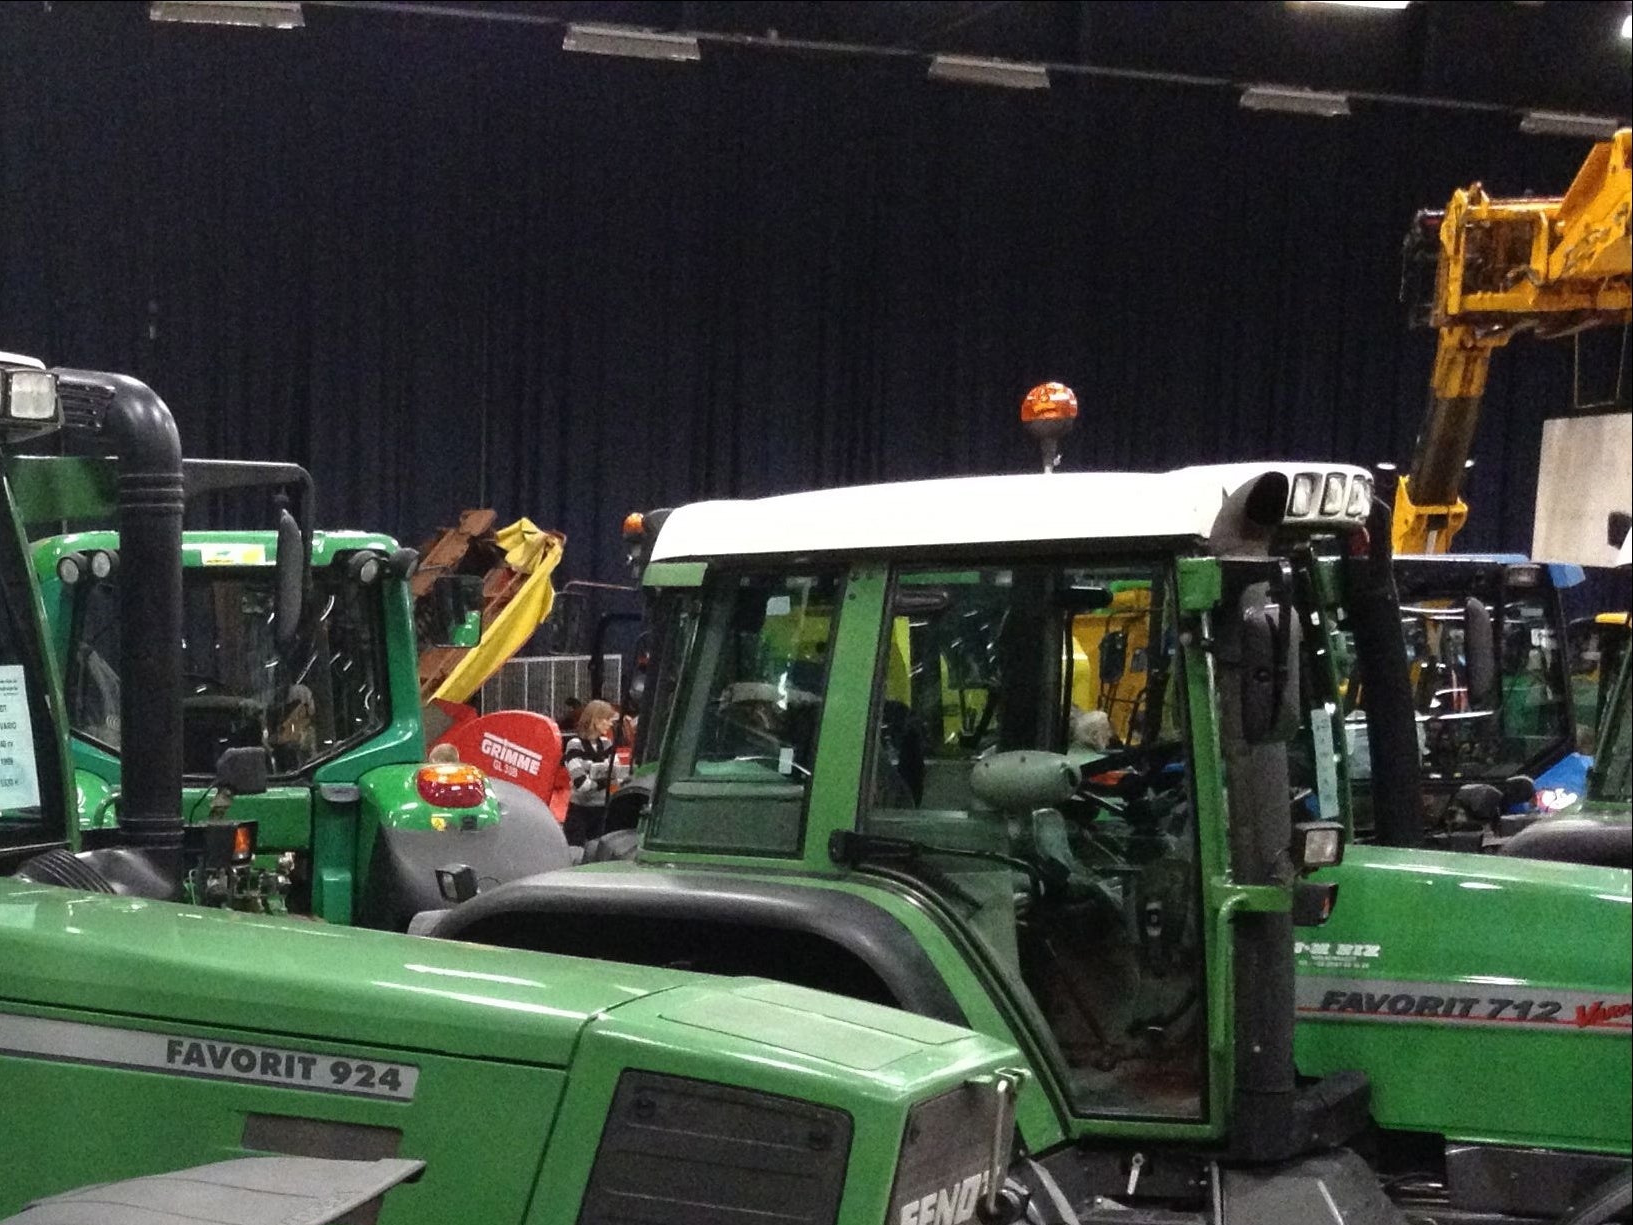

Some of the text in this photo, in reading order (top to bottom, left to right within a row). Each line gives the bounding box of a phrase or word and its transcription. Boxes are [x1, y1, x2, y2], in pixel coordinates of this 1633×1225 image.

[481, 736, 541, 777] GRIMME
[1320, 991, 1479, 1018] FAVORIT
[1487, 998, 1562, 1022] 712
[166, 1038, 402, 1091] FAVORIT 924
